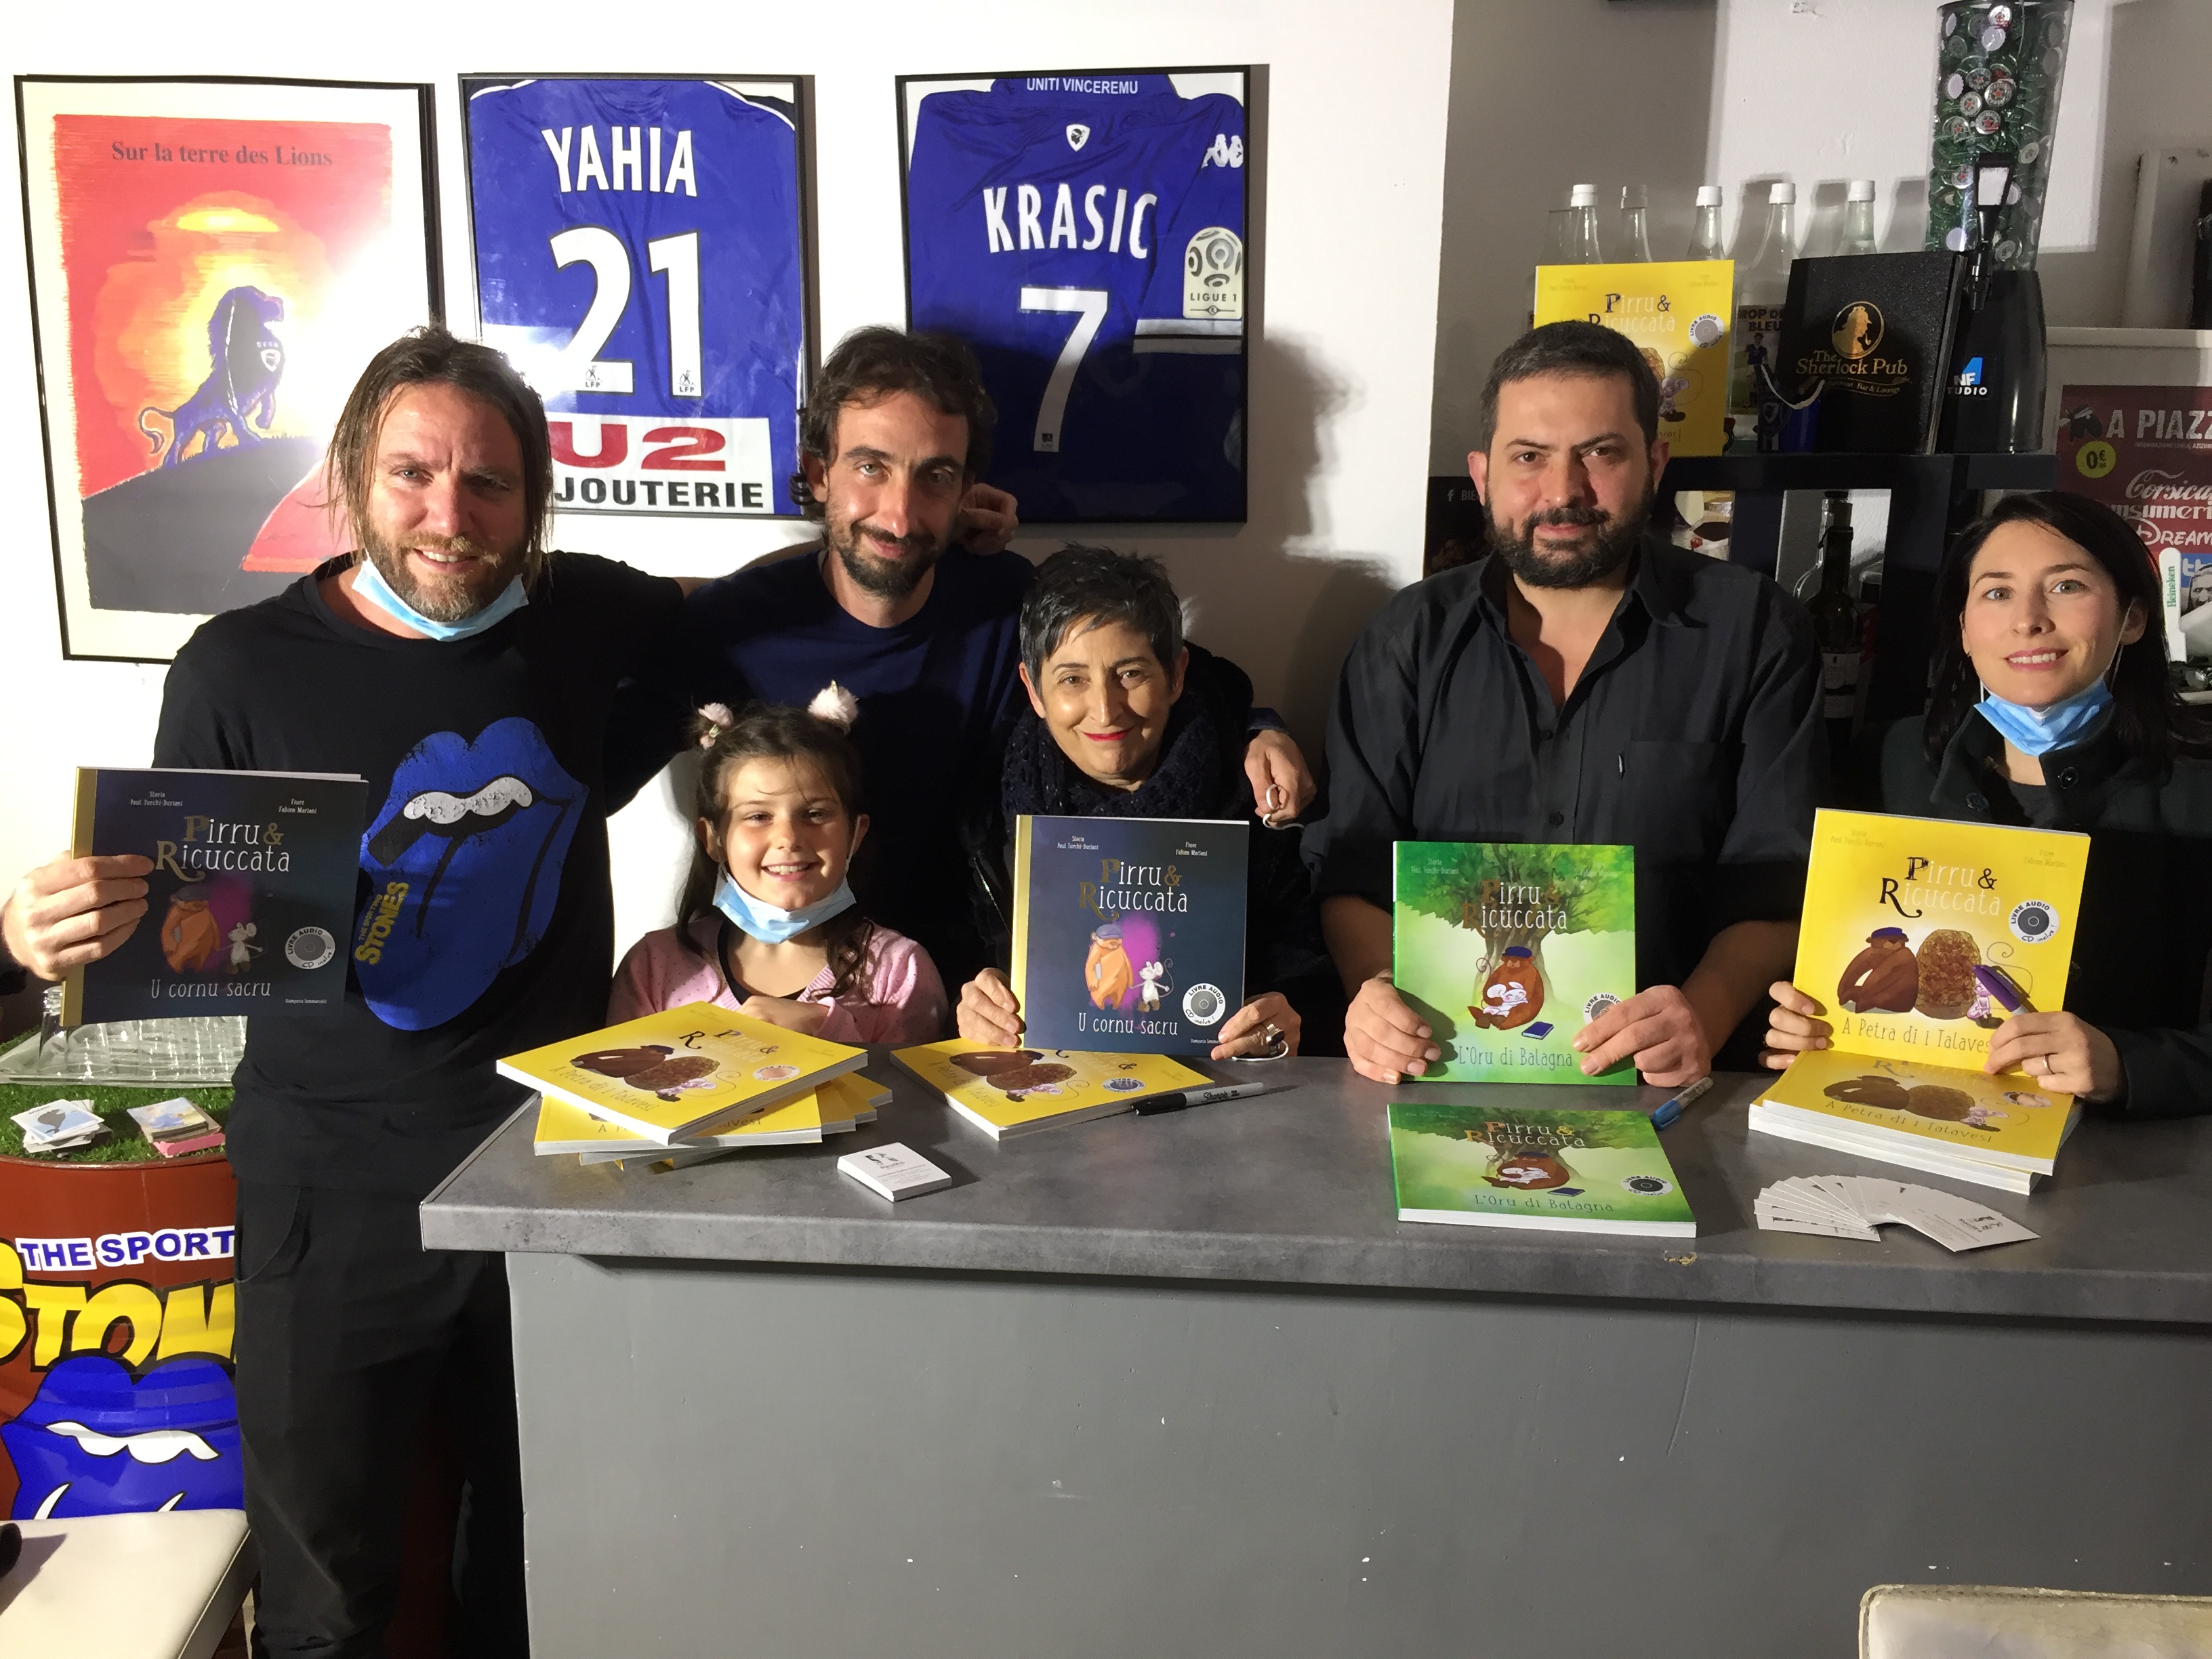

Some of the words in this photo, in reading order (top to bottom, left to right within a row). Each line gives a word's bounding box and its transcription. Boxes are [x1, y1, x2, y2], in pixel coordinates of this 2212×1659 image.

[1027, 77, 1059, 91] UNITI
[1063, 78, 1138, 94] VINCEREMU
[112, 141, 148, 161] Sur
[155, 143, 172, 161] la
[180, 146, 229, 163] terre
[236, 145, 268, 164] des
[276, 146, 333, 166] Lions
[541, 125, 697, 197] YAHIA
[983, 183, 1158, 259] KRASIC
[1191, 293, 1227, 302] LIGUE
[1233, 293, 1237, 302] 1
[1604, 293, 1654, 313] Pirru
[1657, 295, 1671, 312] &
[549, 224, 703, 397] 21
[1690, 320, 1698, 337] LIVRE
[1796, 357, 1868, 375] Sherlock
[1871, 358, 1908, 375] Pub
[1814, 350, 1837, 362] The
[1020, 287, 1108, 453] 7
[2106, 409, 2125, 438] A
[1461, 490, 1479, 501] BIE
[2167, 565, 2177, 608] Heineken
[182, 815, 260, 845] Pirru
[262, 822, 284, 846] &
[154, 840, 289, 882] Ricuccata
[1101, 859, 1161, 886] Pirru
[1164, 865, 1182, 886] &
[1904, 857, 1975, 888] Pirru
[1978, 868, 1998, 890] &
[1079, 882, 1187, 921] Ricuccata
[1481, 879, 1541, 905] Pirru
[1879, 877, 2001, 918] Ricuccata
[355, 882, 409, 964] STONES
[1462, 903, 1567, 939] Ricuccata
[2011, 905, 2024, 924] LIVRE
[2026, 901, 2050, 910] AUDIO
[288, 935, 298, 955] LIVRE
[151, 979, 161, 998] U
[168, 980, 218, 998] cornu
[226, 981, 271, 998] sacru
[1189, 985, 1206, 996] LIVRE
[1208, 987, 1223, 1004] AUDIO
[1584, 996, 1598, 1012] LIVRE
[1078, 1012, 1086, 1031] U
[1093, 1017, 1134, 1033] cornu
[1141, 1019, 1178, 1036] sacru
[1842, 1017, 1851, 1034] A
[1858, 1019, 1896, 1041] Petra
[1903, 1025, 1917, 1044] di
[1925, 1030, 1929, 1046] i
[1458, 1046, 1493, 1065] L'Oru
[1500, 1047, 1513, 1065] di
[1520, 1048, 1572, 1071] Balagna
[1202, 1092, 1228, 1103] Sharpie
[1485, 1121, 1550, 1135] Pirru
[1556, 1126, 1574, 1136] &
[1825, 1101, 1835, 1110] A
[1843, 1104, 1883, 1120] Petra
[1891, 1115, 1905, 1124] di
[1927, 1122, 1992, 1143] Talavesi
[1465, 1130, 1585, 1148] Ricuccata
[1475, 1194, 1516, 1207] L'Oru
[1525, 1197, 1540, 1208] di
[1549, 1199, 1614, 1212] Balagna
[22, 1242, 91, 1268] THE
